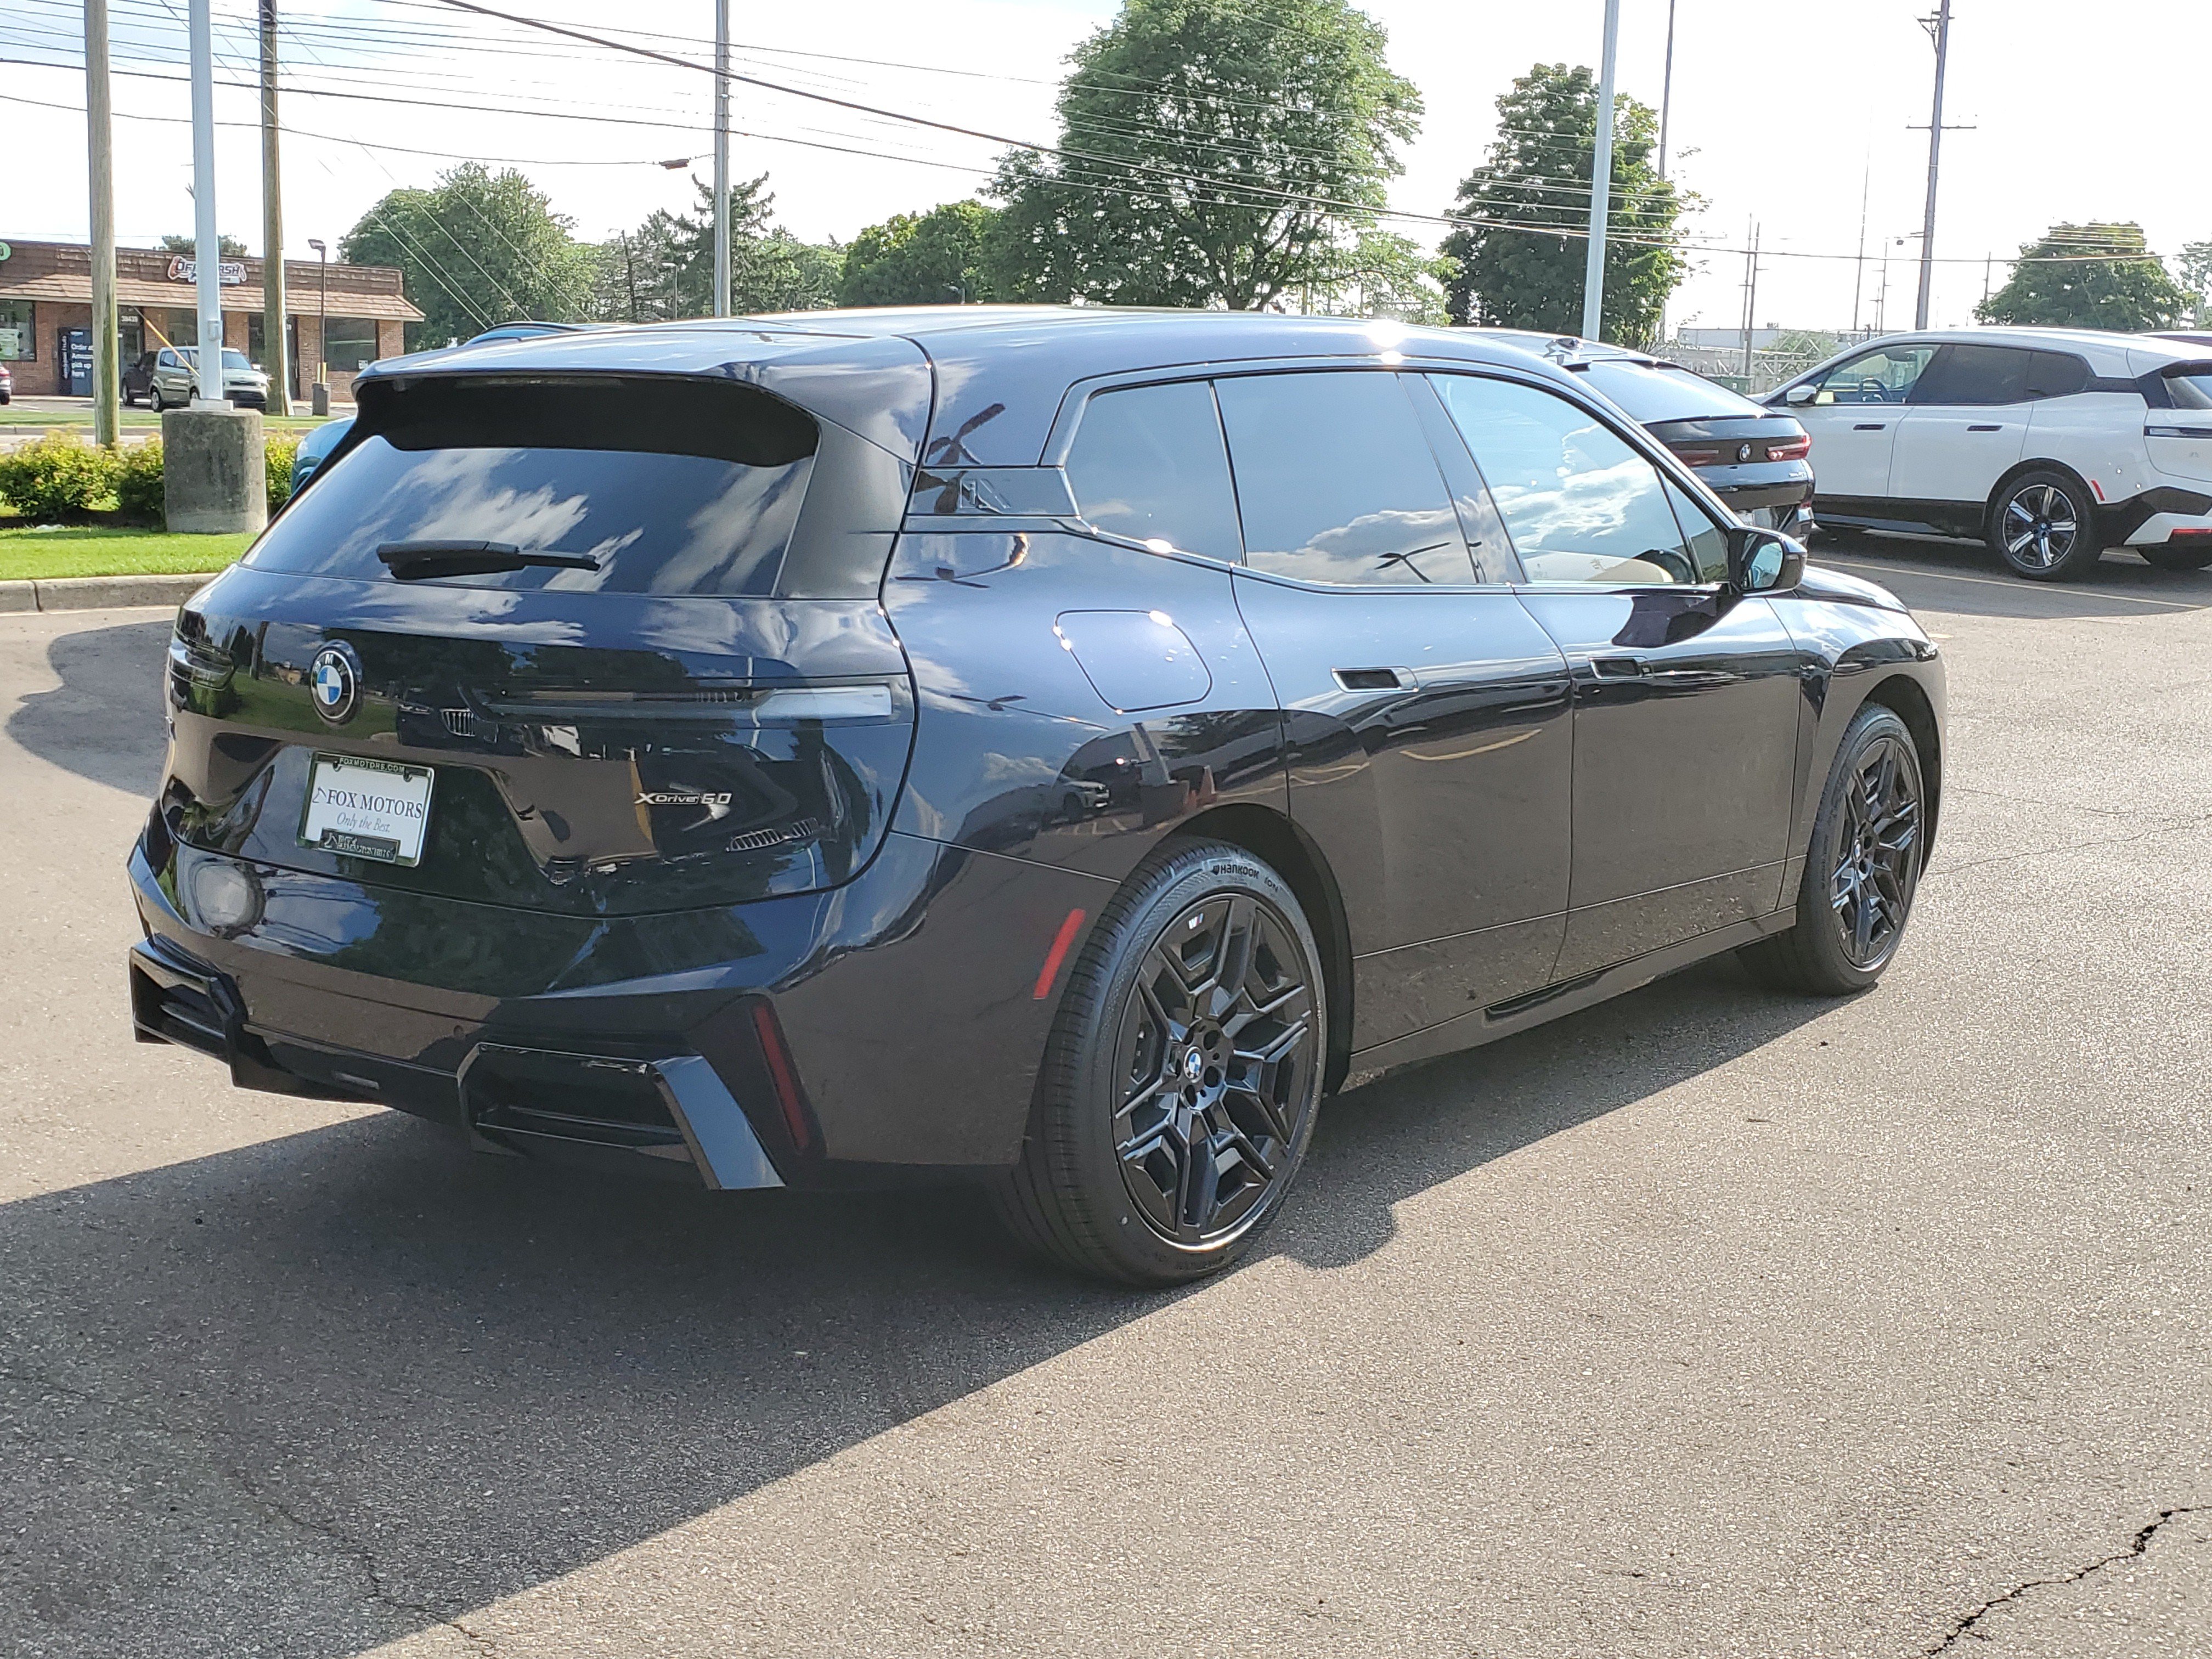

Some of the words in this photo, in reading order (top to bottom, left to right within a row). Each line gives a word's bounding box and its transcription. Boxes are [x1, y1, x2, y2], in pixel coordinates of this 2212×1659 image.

[339, 757, 405, 773] FOXMOTORS.COM
[326, 788, 358, 809] FOX
[359, 794, 422, 819] MOTORS
[336, 811, 358, 831] Only
[358, 815, 373, 830] the
